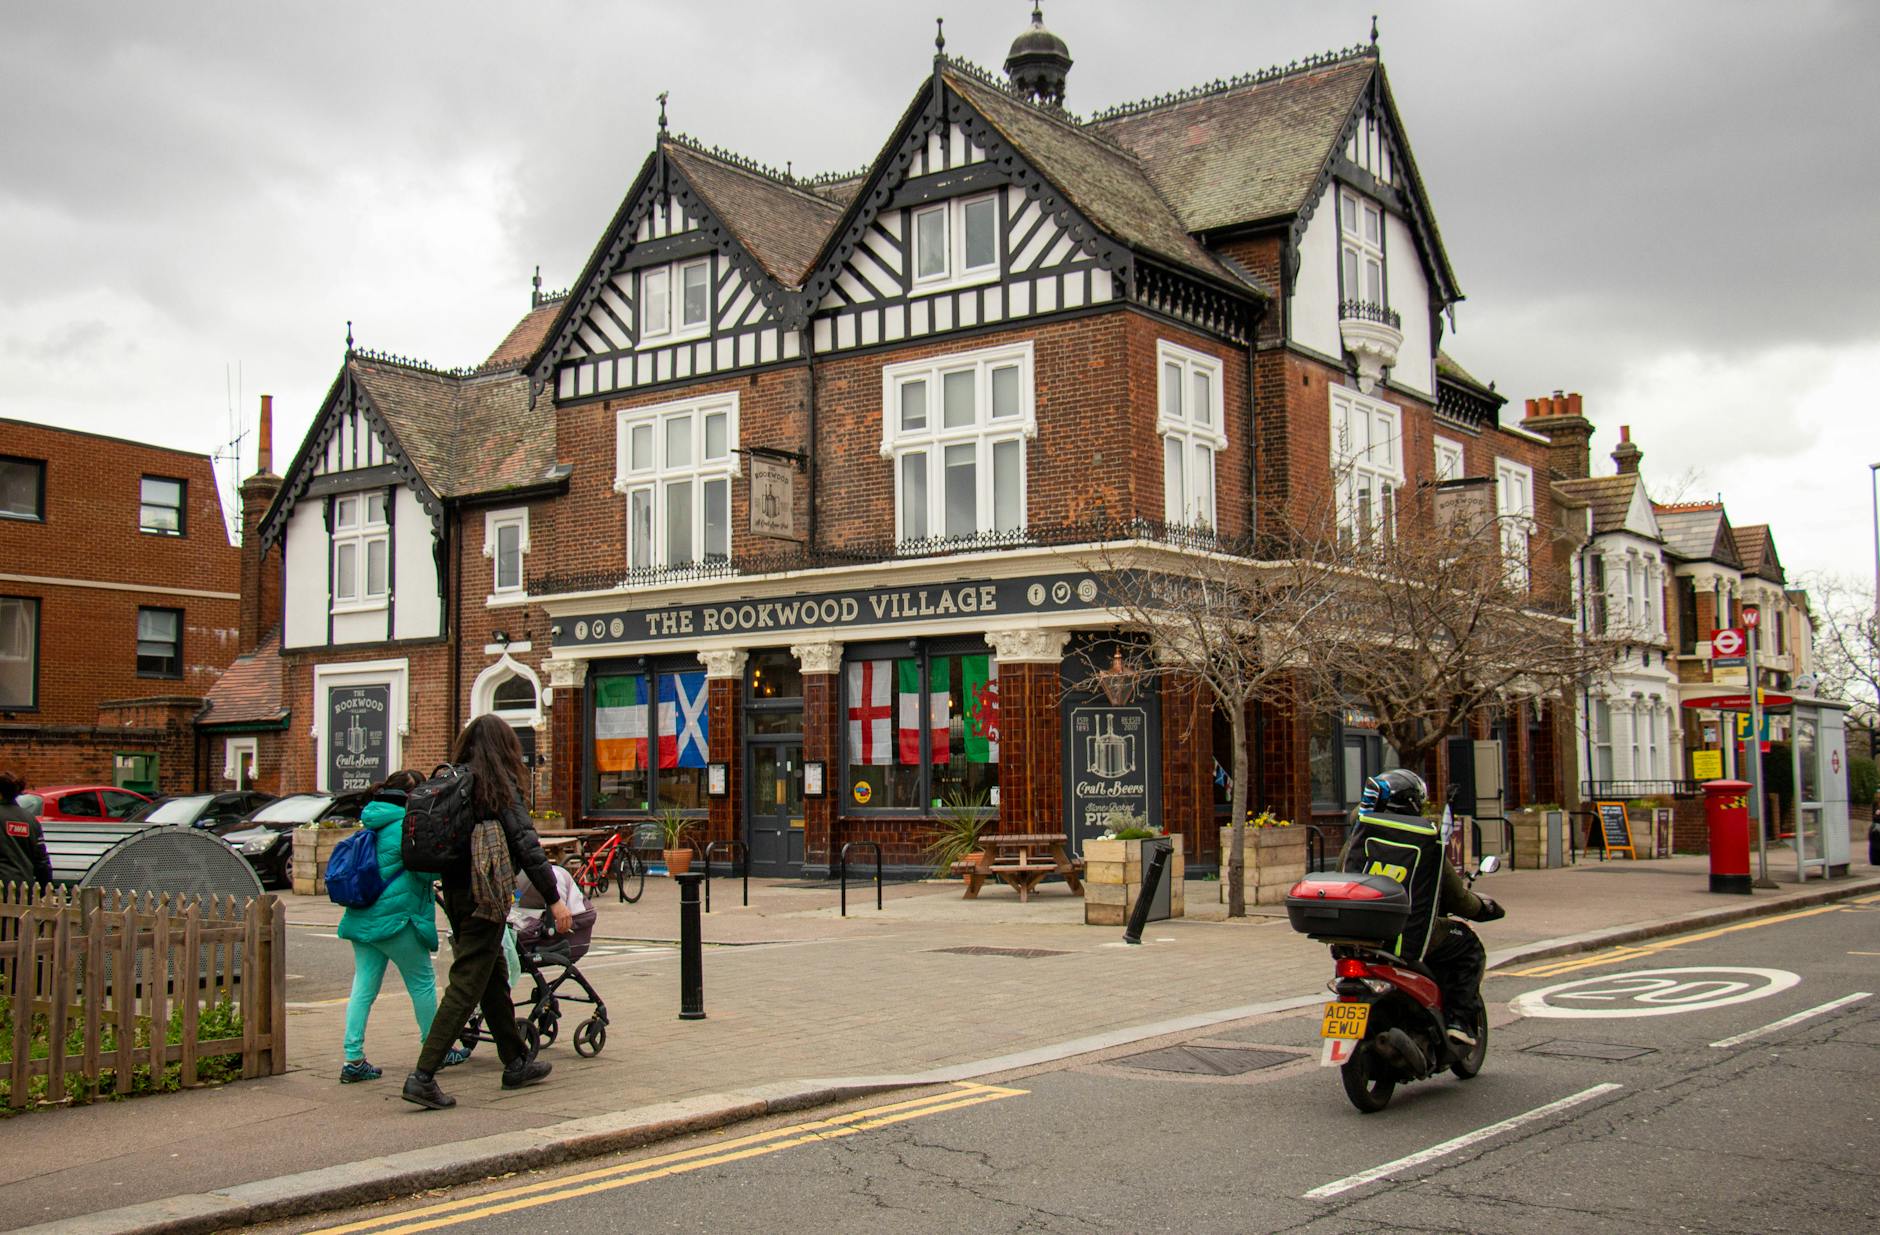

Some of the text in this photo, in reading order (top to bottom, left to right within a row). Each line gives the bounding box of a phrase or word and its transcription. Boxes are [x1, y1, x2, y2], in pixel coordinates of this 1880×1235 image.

[755, 471, 789, 484] ROOKWOOD
[646, 586, 997, 636] THE ROOKWOOD VILLAGE
[1743, 613, 1757, 624] W
[335, 698, 384, 714] ROOKWOOD
[336, 753, 379, 769] Craft Beers
[343, 779, 371, 789] PIZZA
[1076, 781, 1144, 798] Craft Beers
[1553, 978, 1749, 1003] 20
[1325, 1006, 1367, 1020] AO63
[1327, 1021, 1360, 1035] EWU
[1330, 1041, 1347, 1061] L
